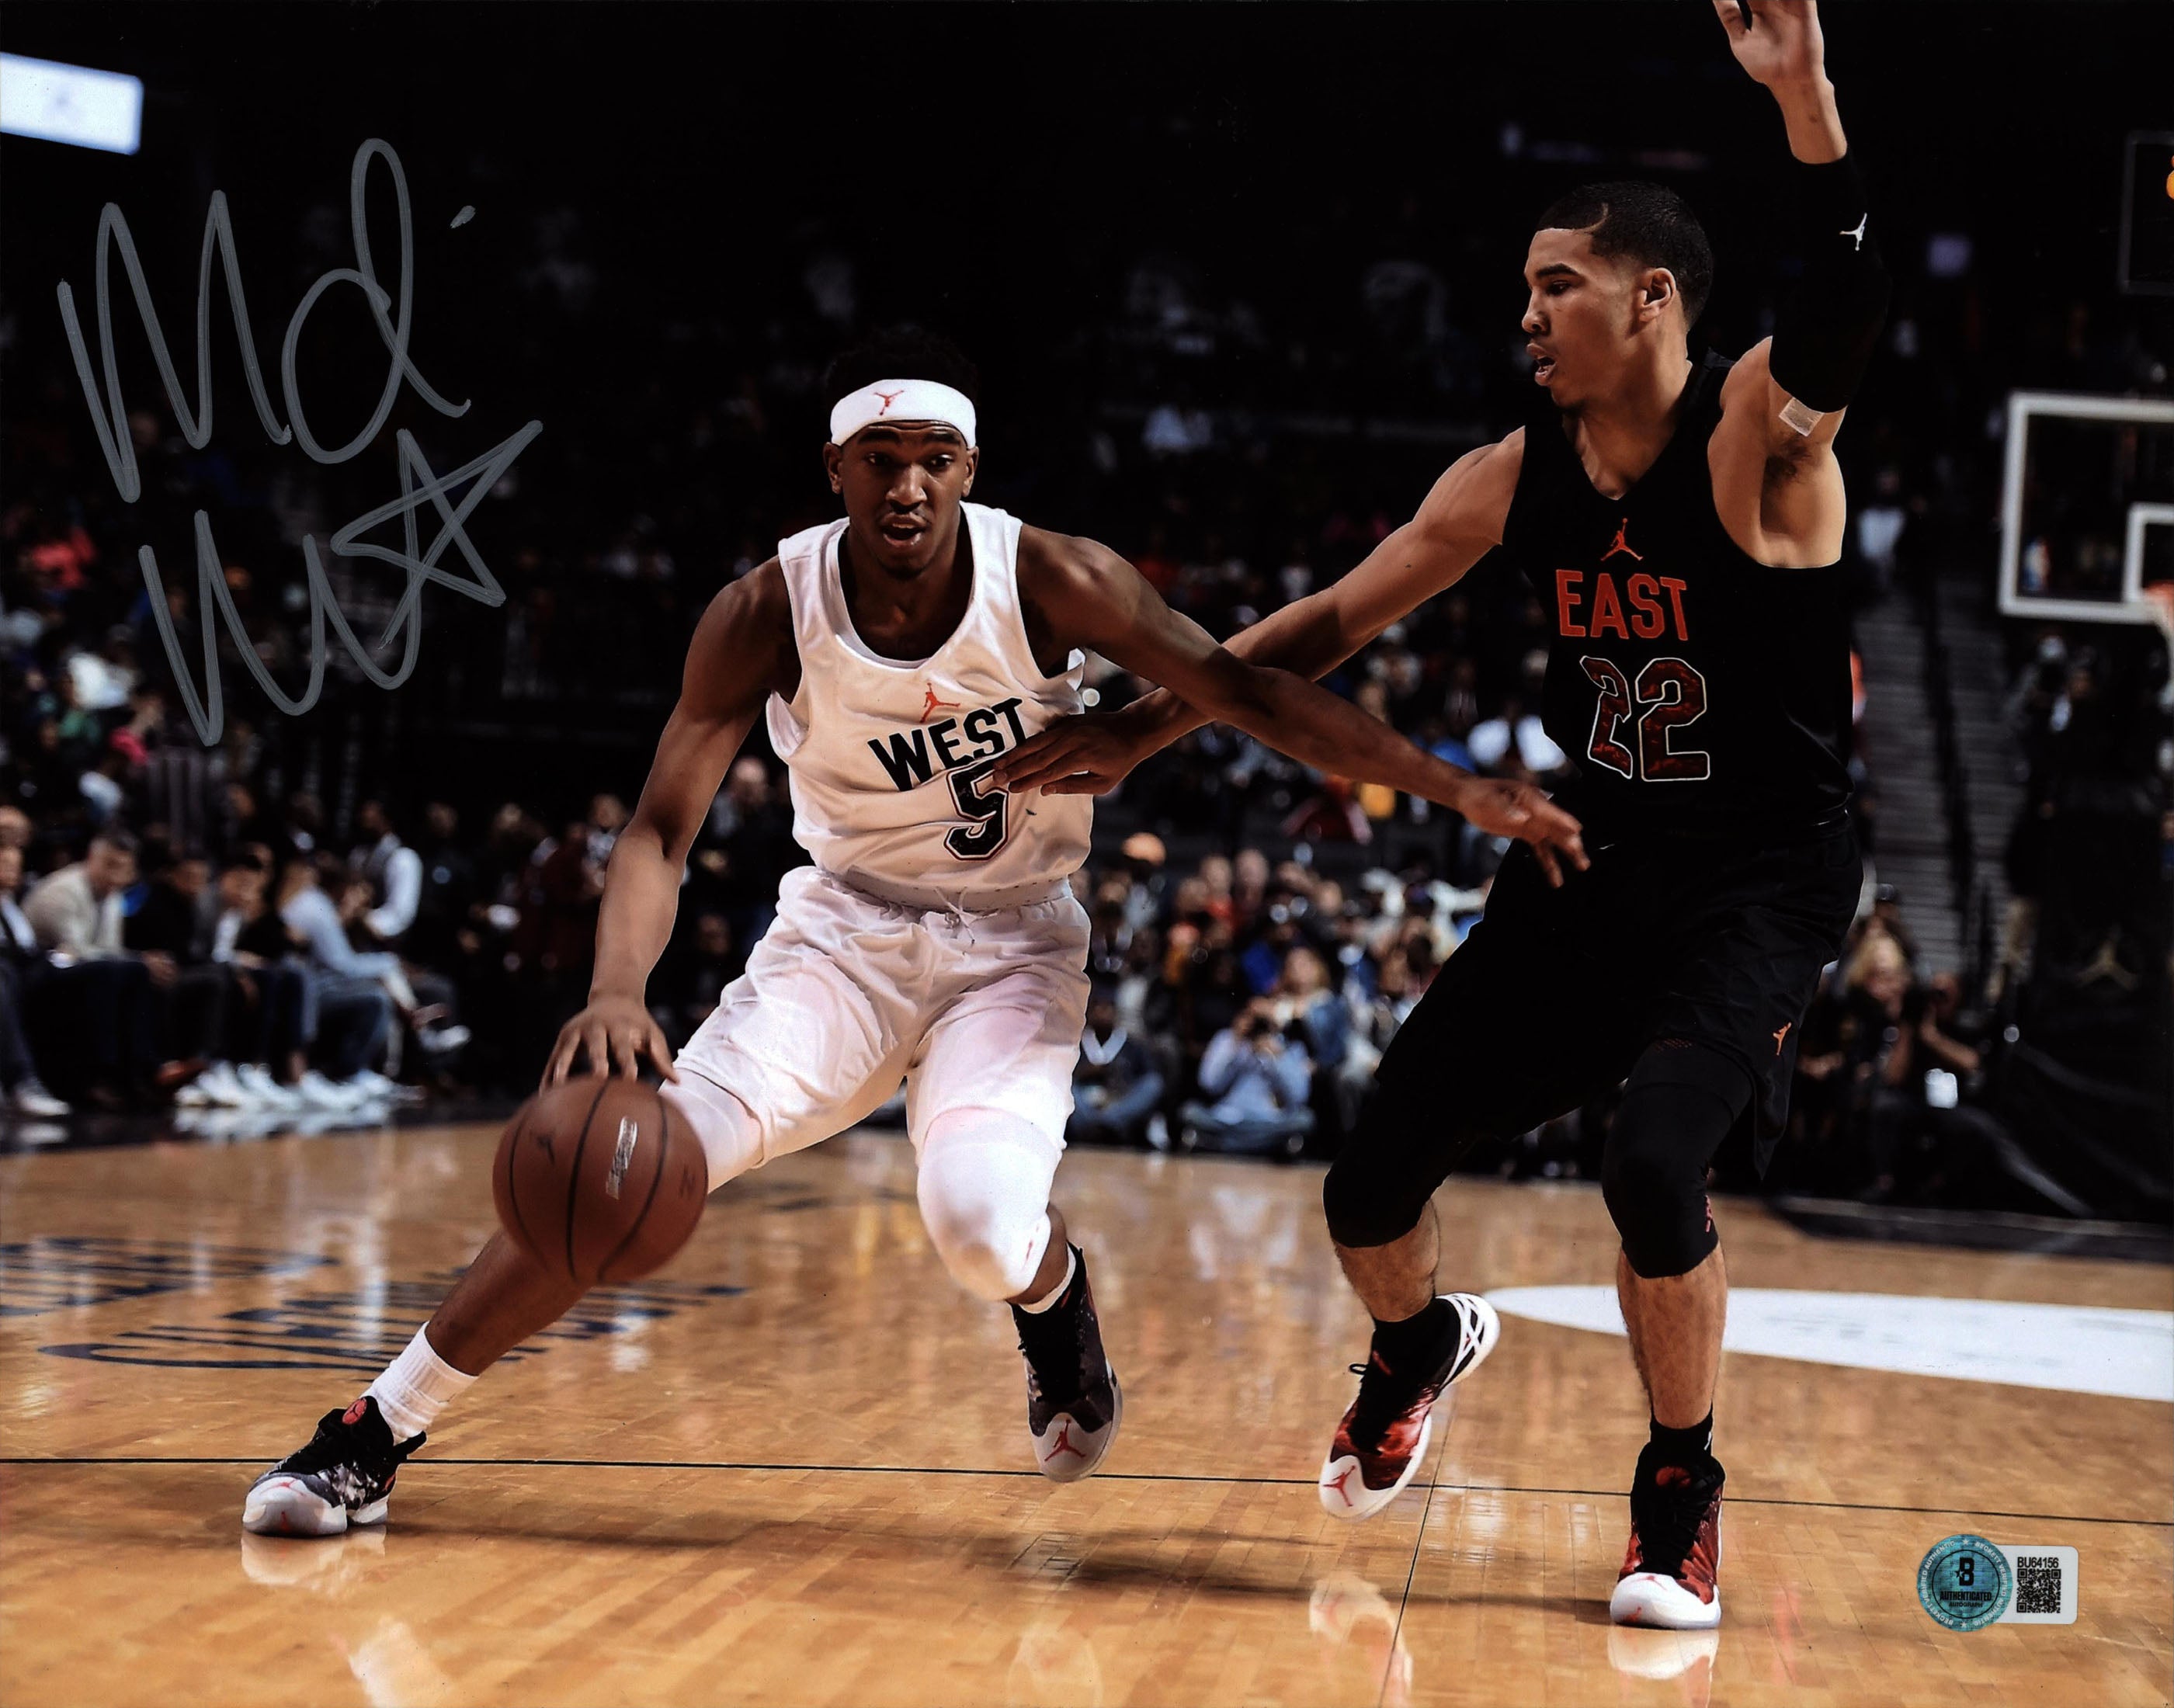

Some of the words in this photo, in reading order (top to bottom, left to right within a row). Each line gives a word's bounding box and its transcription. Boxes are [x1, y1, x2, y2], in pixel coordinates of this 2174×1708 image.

[1555, 568, 1689, 641] EAST
[867, 696, 1026, 792] WEST
[1579, 655, 1710, 783] 22
[943, 757, 1010, 861] 5
[1924, 1540, 1957, 1570] AUTHENTIC
[1974, 1541, 2001, 1564] BECKETT
[2017, 1557, 2059, 1568] BU64156
[1940, 1591, 1992, 1602] AUTHENTICATED
